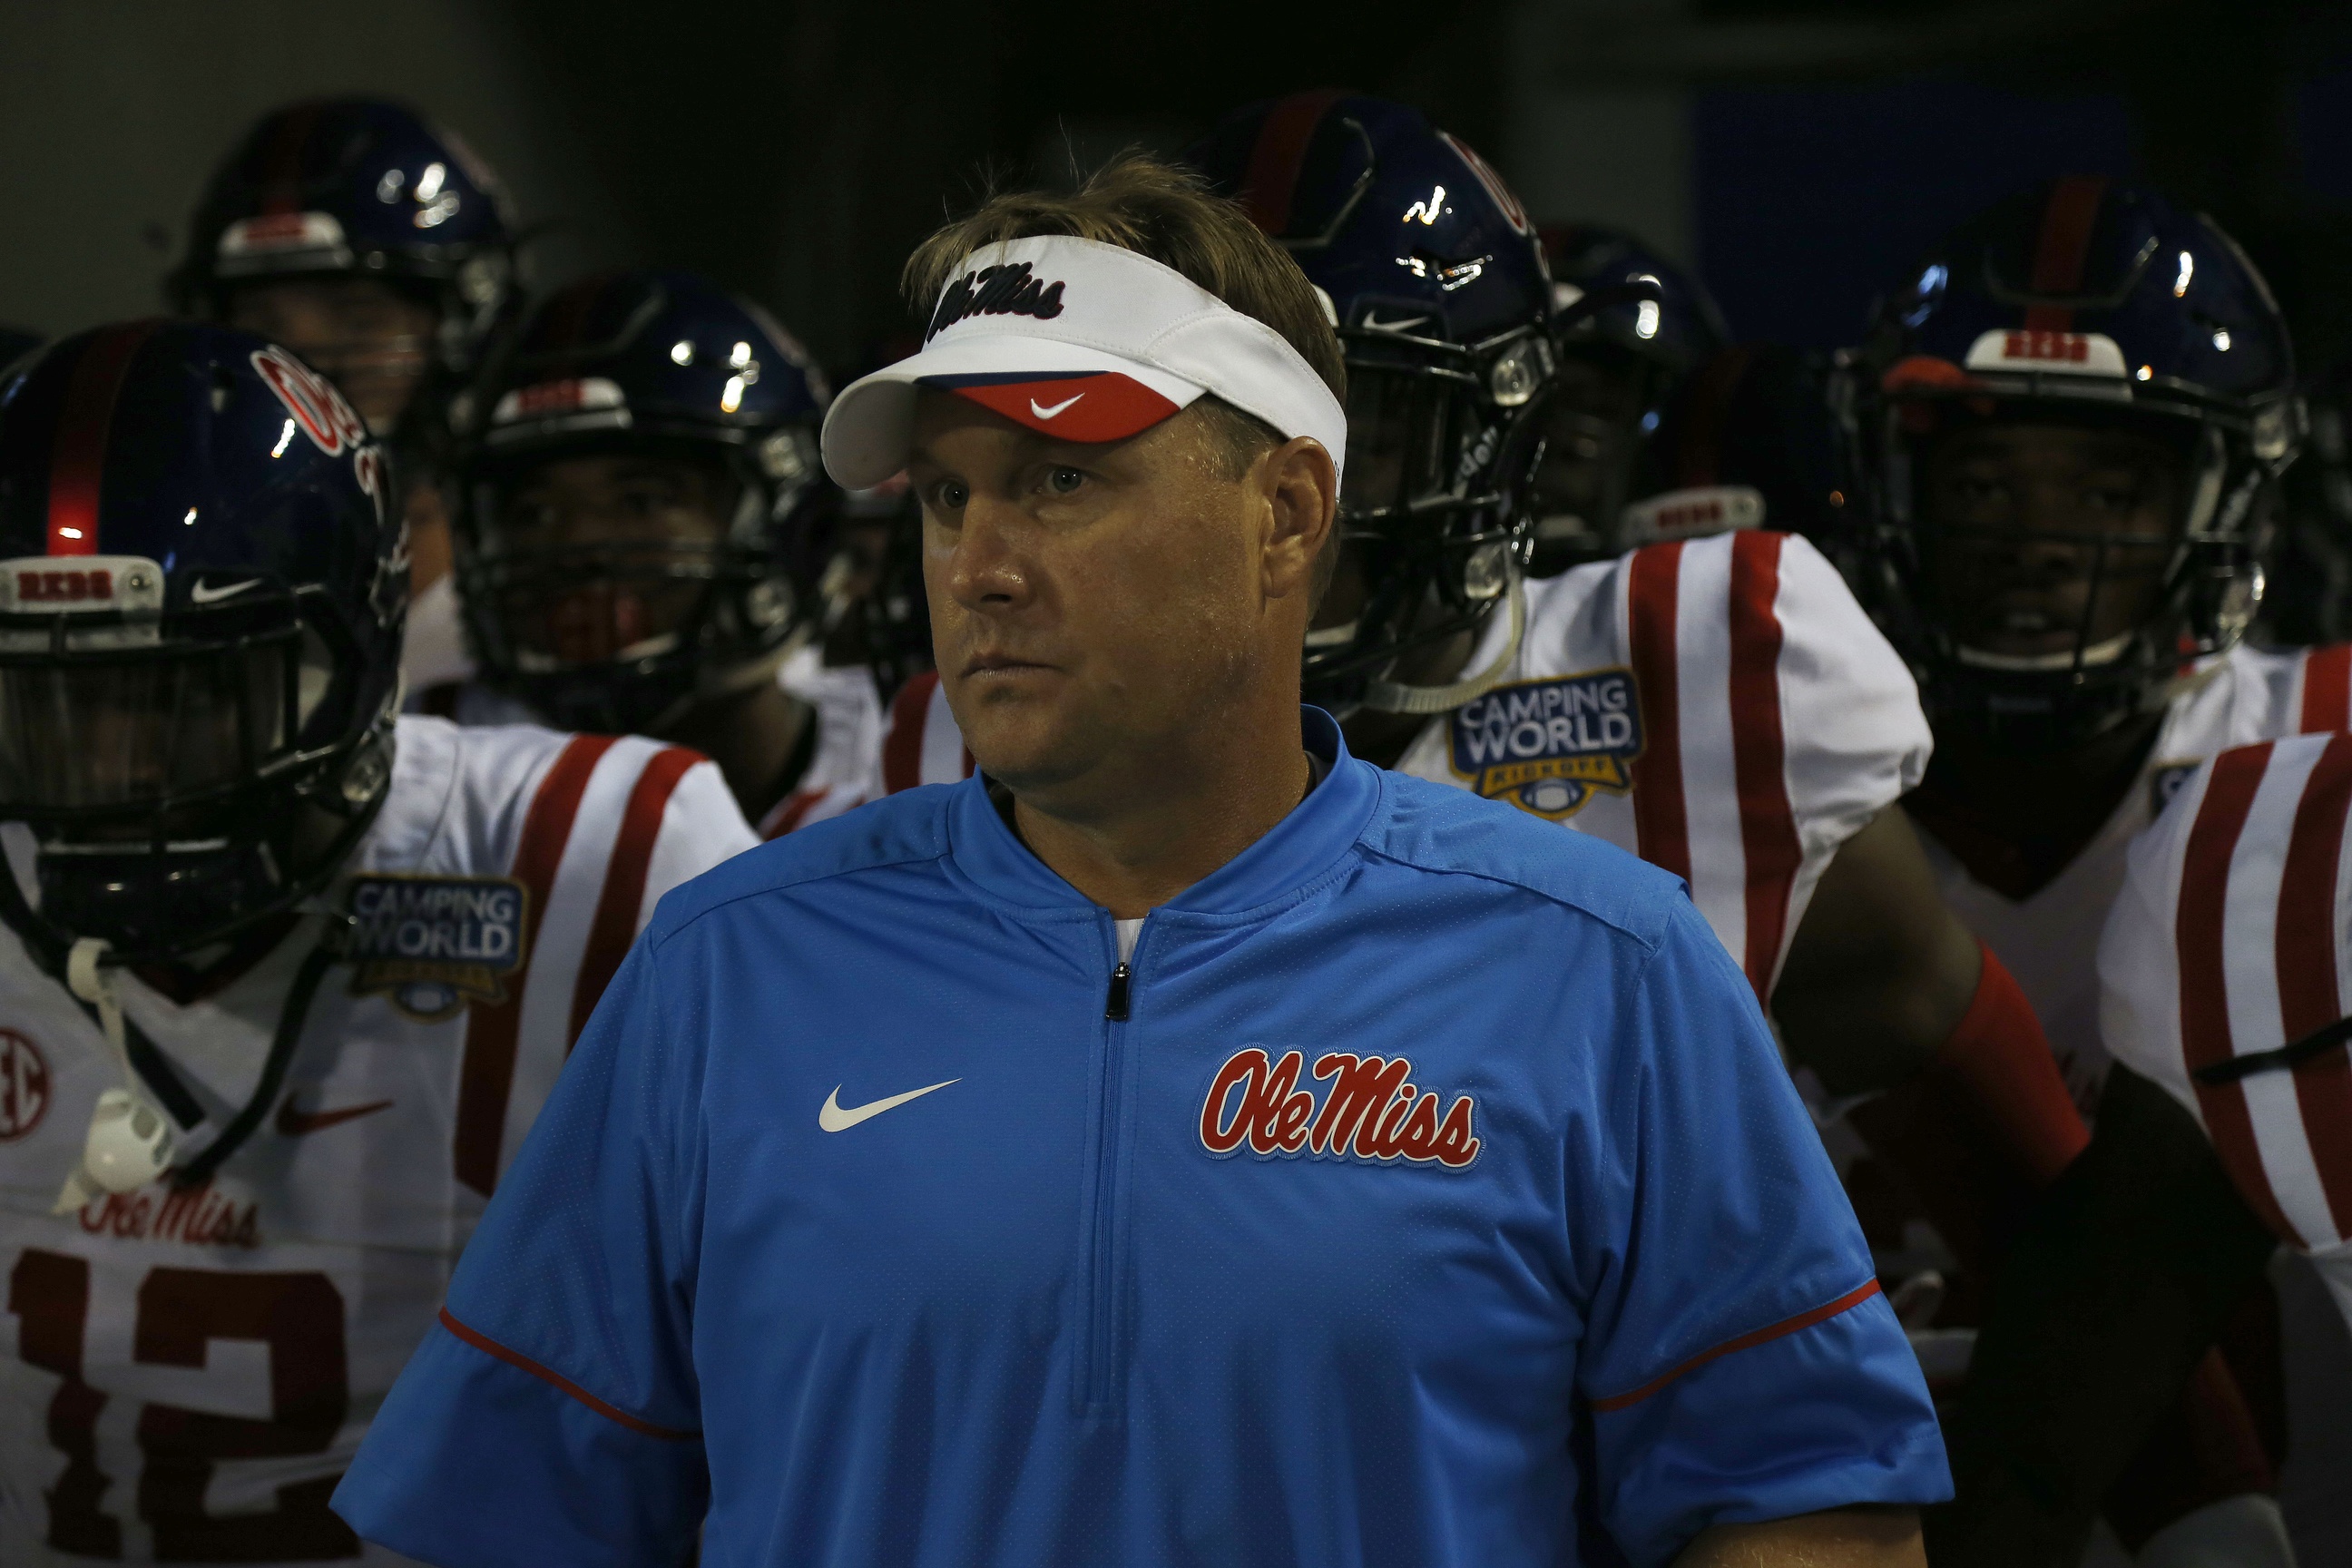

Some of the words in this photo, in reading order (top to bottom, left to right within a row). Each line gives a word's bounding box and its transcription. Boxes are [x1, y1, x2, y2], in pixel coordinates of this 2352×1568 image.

[963, 261, 1065, 319] Miss
[1459, 678, 1629, 730] CAMPING
[1462, 710, 1632, 765] WORLD
[354, 882, 514, 924] CAMPING
[347, 916, 514, 960] WORLD
[1200, 1048, 1314, 1154] Ole
[1309, 1053, 1480, 1167] Miss
[155, 1167, 261, 1250] Miss
[7, 1249, 363, 1563] 12
